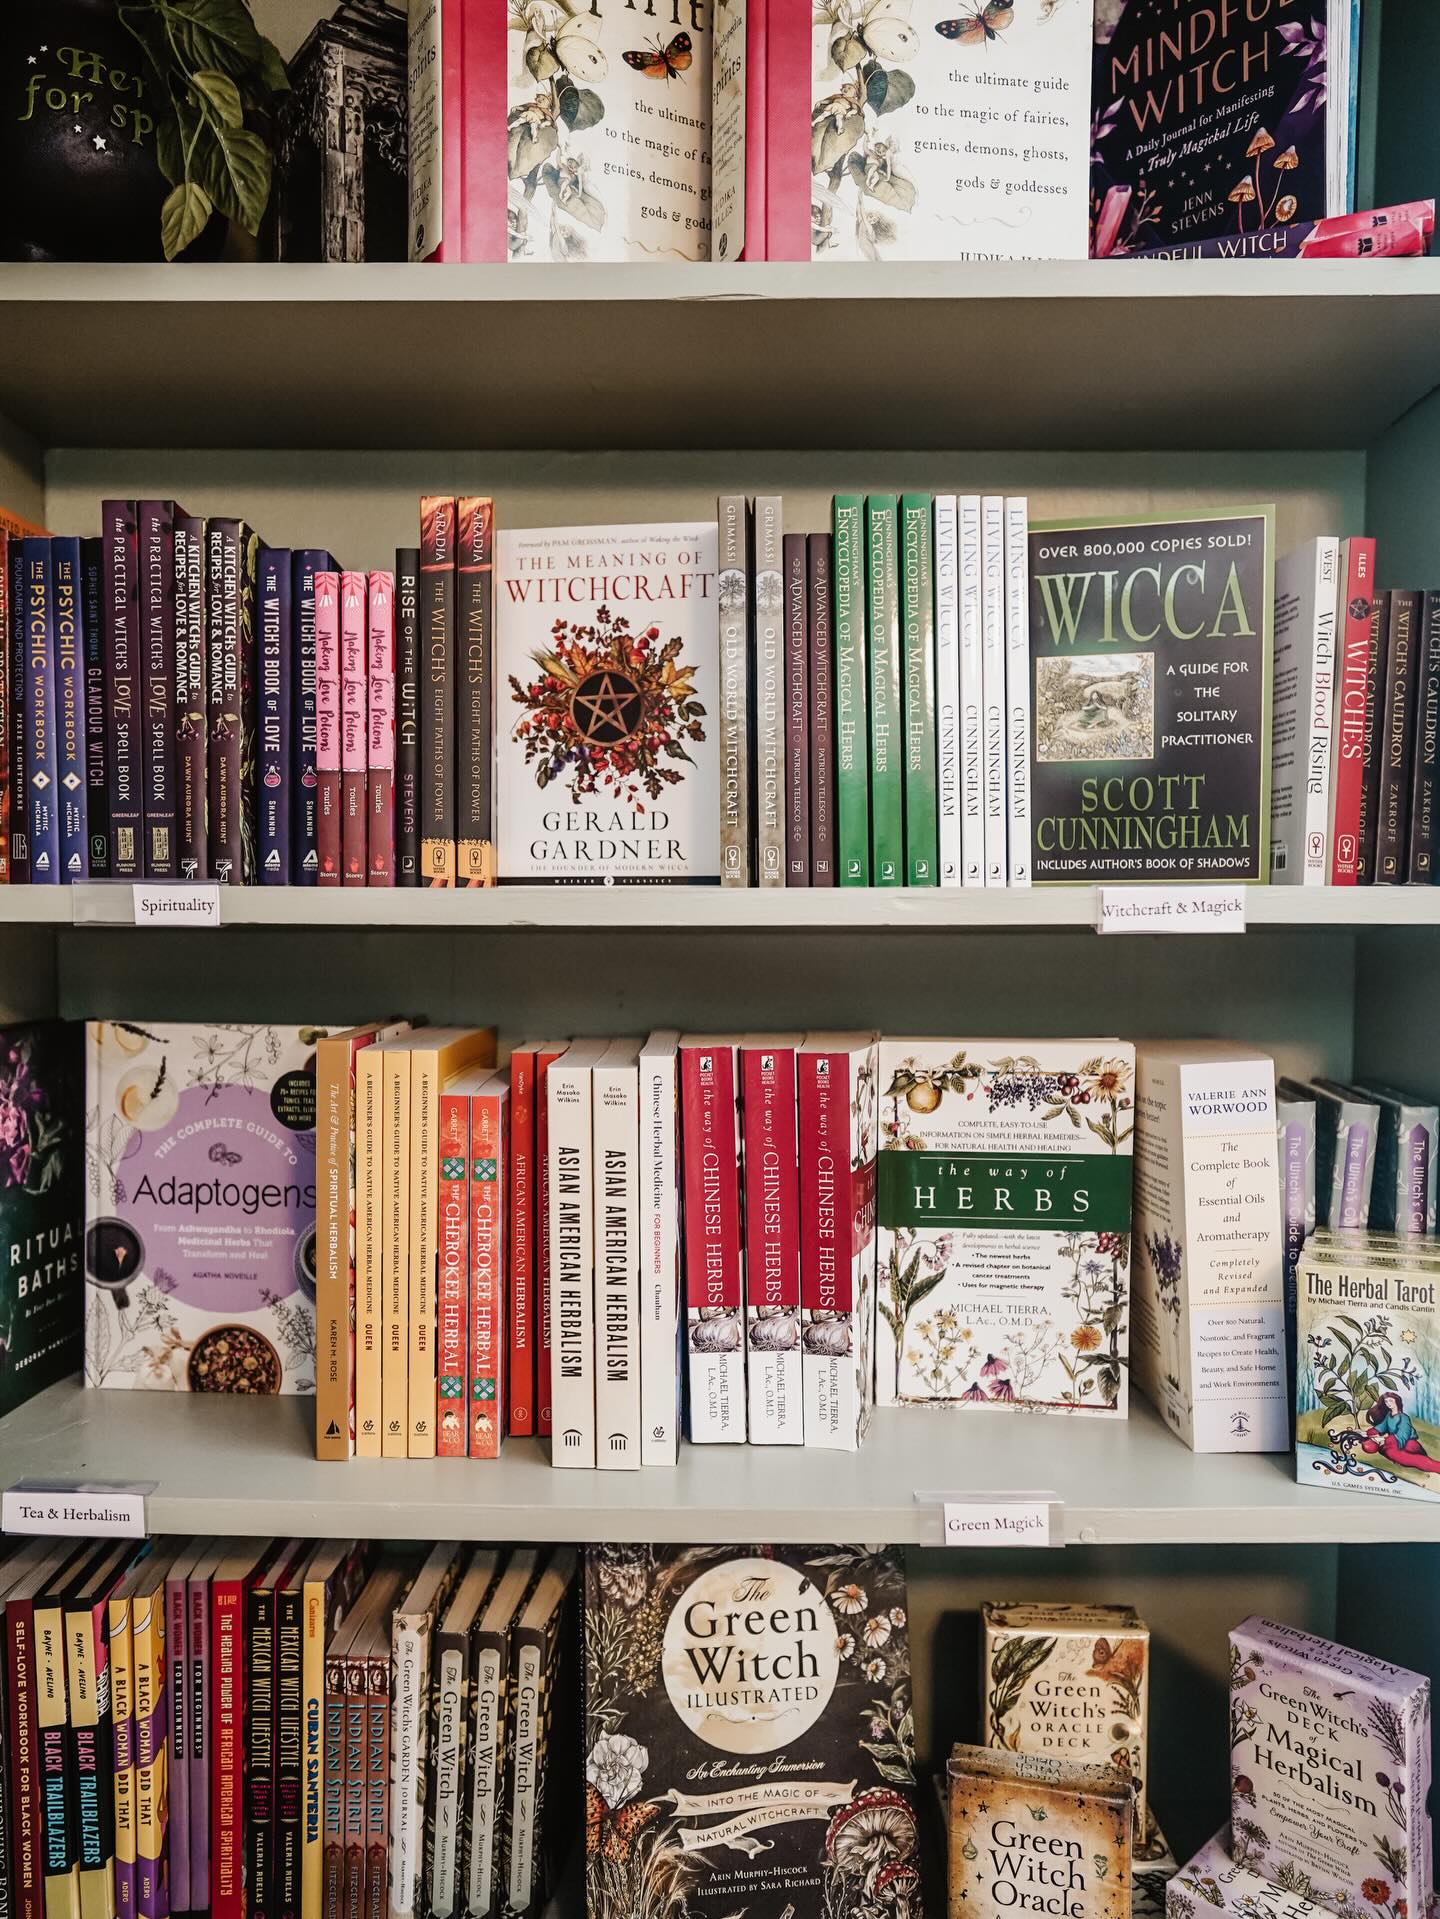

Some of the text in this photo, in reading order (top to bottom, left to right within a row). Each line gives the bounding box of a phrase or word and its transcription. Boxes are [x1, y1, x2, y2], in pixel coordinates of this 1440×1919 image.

[948, 69, 1070, 92] the ultimate guide
[1129, 31, 1269, 133] WITCH
[916, 103, 1070, 128] to the magic of fairies,
[1126, 84, 1275, 161] A Daily Journal for Manifesting
[913, 137, 1069, 163] genies, demons, ghosts,
[1139, 112, 1259, 176] a Truly Magickal Life
[955, 174, 1069, 196] gods & goddesses
[1184, 190, 1213, 212] JENN
[1171, 202, 1224, 234] STEVENS
[516, 551, 704, 570] THE MEANING OF
[1039, 535, 1251, 559] OVER 800,000 COPIES SOLD!
[1323, 550, 1331, 583] WEST
[1357, 553, 1366, 578] ILLES
[504, 572, 715, 603] WITCHCRAFT
[1034, 560, 1256, 646] WICCA
[31, 585, 46, 668] PSYCHIC
[838, 507, 854, 769] ENCYCLOPEDIA OF MAGICAL HERBS
[264, 576, 280, 751] THE WITCH'S BOOK OF LOVE
[1166, 662, 1249, 675] A GUIDE FOR
[1194, 687, 1219, 698] THE
[1308, 611, 1334, 795] Witch Blood Rising
[1343, 640, 1368, 759] WITCHES
[35, 675, 45, 759] WORKBOOK
[1177, 710, 1237, 722] SOLITARY
[1161, 733, 1253, 748] PRACTITIONER
[1081, 773, 1206, 815] SCOTT
[542, 810, 669, 832] GERALD
[1037, 814, 1251, 851] CUNNINGHAM
[530, 839, 688, 861] GARDNER
[1037, 857, 1250, 870] INCLUDES AUTHOR'S BOOK OF SHADOWS
[141, 899, 215, 915] Spirituality
[1103, 899, 1242, 917] Witchcraft & Magick
[1188, 1089, 1267, 1101] VALERIE ANN
[1190, 1102, 1268, 1116] WORWOOD
[154, 1118, 298, 1166] THE COMPLETE GUIDE TO
[653, 1075, 662, 1209] Chinese Herbal Medicine
[1220, 1142, 1239, 1153] The
[938, 1164, 1069, 1180] the way of
[1190, 1159, 1269, 1173] Complete Book
[132, 1174, 316, 1215] Adaptogens
[1226, 1177, 1236, 1189] of
[914, 1186, 1090, 1212] HERBS
[1198, 1194, 1265, 1207] Essential Oils
[702, 1153, 724, 1303] CHINESE HERBS
[1223, 1213, 1241, 1223] and
[445, 1203, 460, 1293] CHEROKEE
[1197, 1229, 1269, 1244] Aromatherapy
[558, 1146, 583, 1378] ASIAN AMERICAN HERBALISM
[17, 1255, 79, 1299] BATHS
[1306, 1272, 1435, 1304] The Herbal Tarot
[951, 1303, 1051, 1316] MICHAEL TIERRA,
[443, 1297, 459, 1371] HERBAL
[20, 1506, 131, 1523] Tea & Herbalism
[949, 1515, 1044, 1533] Green Magick
[732, 1577, 769, 1602] The
[684, 1601, 819, 1638] Green
[684, 1641, 820, 1685] Witch
[687, 1686, 818, 1708] ILLUSTRATED
[1034, 1680, 1101, 1698] Green
[1030, 1701, 1105, 1718] Witch's
[1031, 1722, 1104, 1734] ORACLE
[1043, 1737, 1091, 1747] DECK
[15, 1621, 32, 1888] SELF-LOVE WORKBOOK FOR BLACK WOMEN
[115, 1667, 130, 1830] A BLACK WOMAN DID THAT
[1266, 1723, 1363, 1782] Magical
[307, 1698, 321, 1844] CUBAN SANTERIA
[327, 1703, 344, 1833] INDIAN SPIRIT
[1254, 1744, 1378, 1818] Herbalism
[44, 1732, 66, 1868] BLACK TRAILBLAZERS
[707, 1789, 820, 1807] INTO THE MAGIC OF
[696, 1807, 820, 1844] NATURAL WITCHCRAFT
[992, 1820, 1084, 1860] Green
[988, 1849, 1087, 1891] Witch
[992, 1881, 1085, 1918] Oracle
